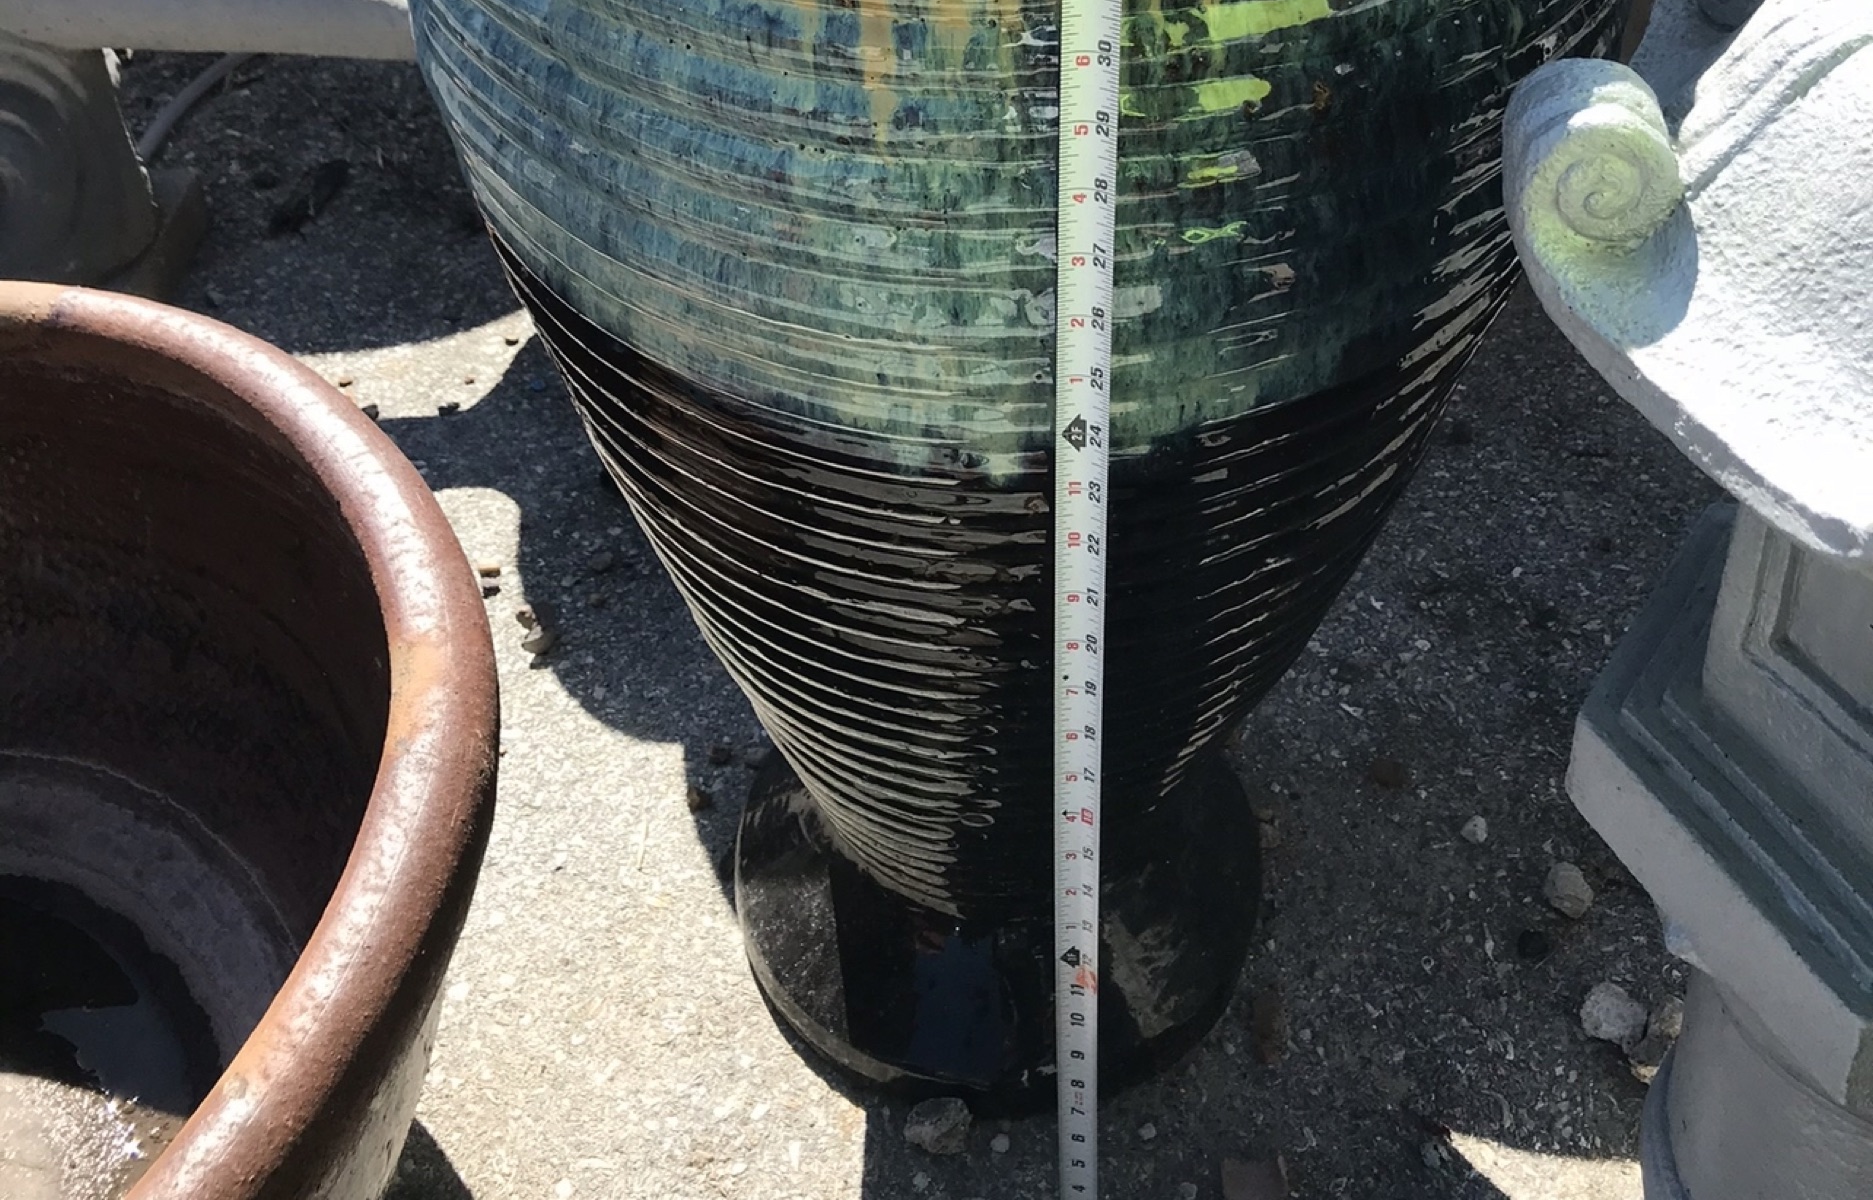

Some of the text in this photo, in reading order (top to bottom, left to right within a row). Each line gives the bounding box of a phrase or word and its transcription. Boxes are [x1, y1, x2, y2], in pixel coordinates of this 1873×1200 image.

[1098, 40, 1111, 66] 30
[1076, 55, 1090, 66] 6
[1074, 124, 1088, 135] 5
[1096, 110, 1110, 137] 29
[1073, 192, 1087, 203] 4
[1094, 178, 1108, 204] 28
[1072, 256, 1085, 266] 3
[1093, 243, 1106, 269] 27
[1071, 318, 1085, 328] 2
[1091, 307, 1104, 331] 26
[1091, 367, 1103, 390] 25
[1071, 427, 1082, 441] 2F
[1090, 425, 1101, 447] 24
[1069, 482, 1081, 495] 11
[1088, 481, 1100, 503] 23
[1068, 532, 1081, 548] 10
[1088, 534, 1099, 555] 22
[1066, 594, 1080, 602] 9
[1087, 587, 1098, 606] 21
[1066, 642, 1078, 650] 8
[1086, 634, 1097, 654] 20
[1085, 681, 1096, 697] 19
[1066, 732, 1078, 740] 6
[1085, 726, 1096, 740] 18
[1084, 768, 1095, 783] 17
[1082, 847, 1093, 860] 15
[1082, 883, 1093, 898] 14
[1071, 984, 1084, 996] 11
[1071, 1012, 1085, 1026] 10
[1071, 1051, 1084, 1060] 9
[1071, 1079, 1084, 1088] 8
[1071, 1107, 1085, 1115] 7
[1072, 1134, 1085, 1143] 6
[1072, 1159, 1085, 1168] 5
[1072, 1185, 1085, 1193] 4
